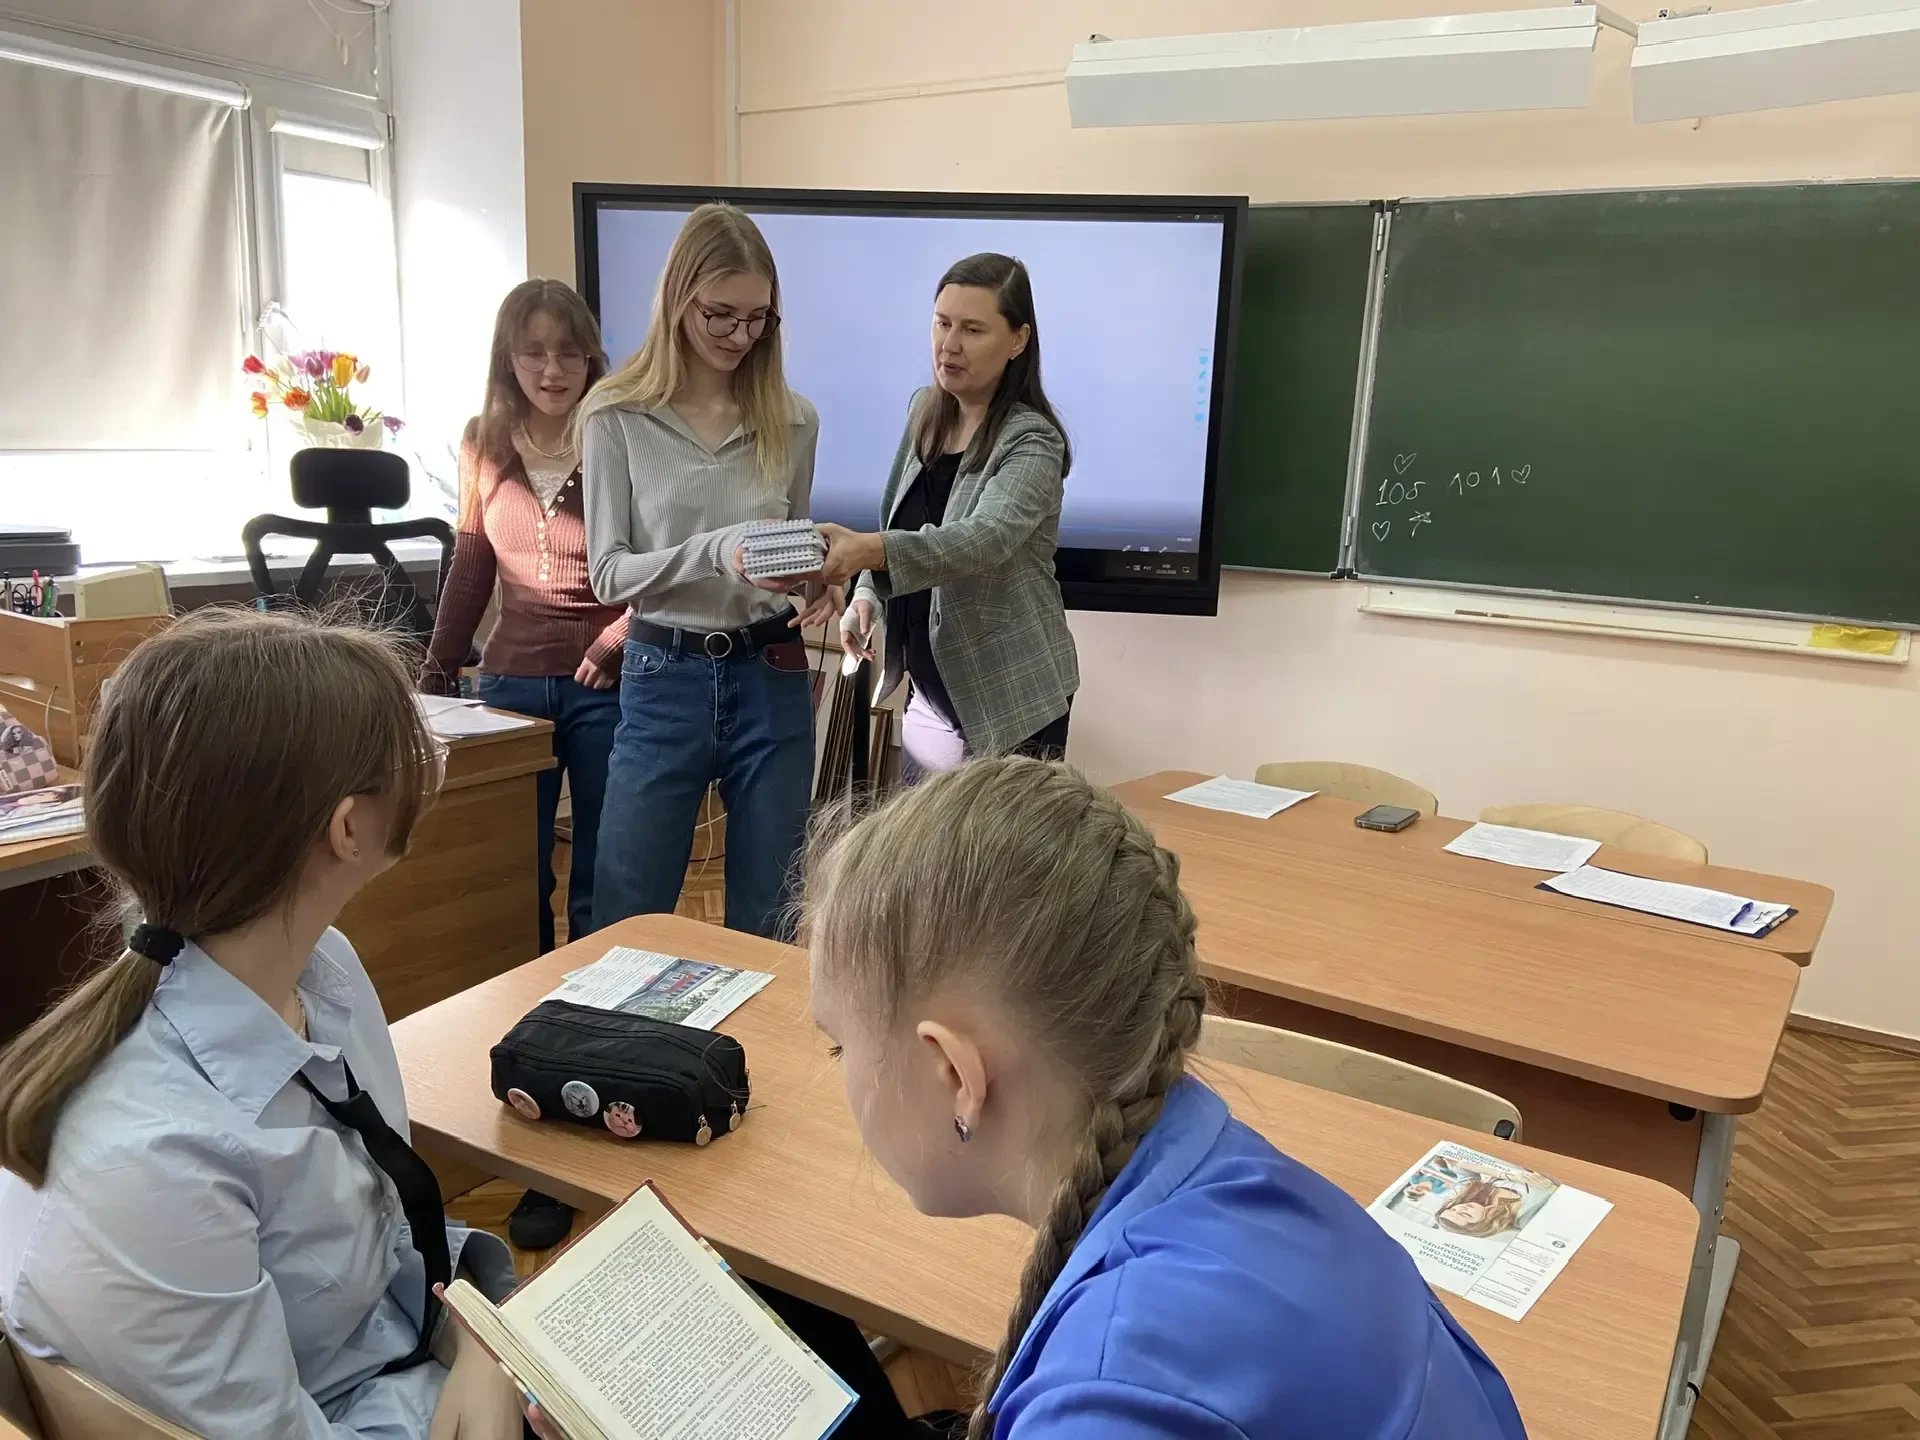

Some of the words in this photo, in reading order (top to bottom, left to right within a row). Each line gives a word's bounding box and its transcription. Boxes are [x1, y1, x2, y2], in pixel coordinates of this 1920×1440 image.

[1403, 1231, 1483, 1267] ЭКОНОМИЧЕСКИЙ
[1419, 1249, 1474, 1276] СУРГУТСКИЙ
[1420, 1244, 1478, 1271] ФИНАНСОВО-
[1443, 1242, 1486, 1263] КОЛЛЕДЖ
